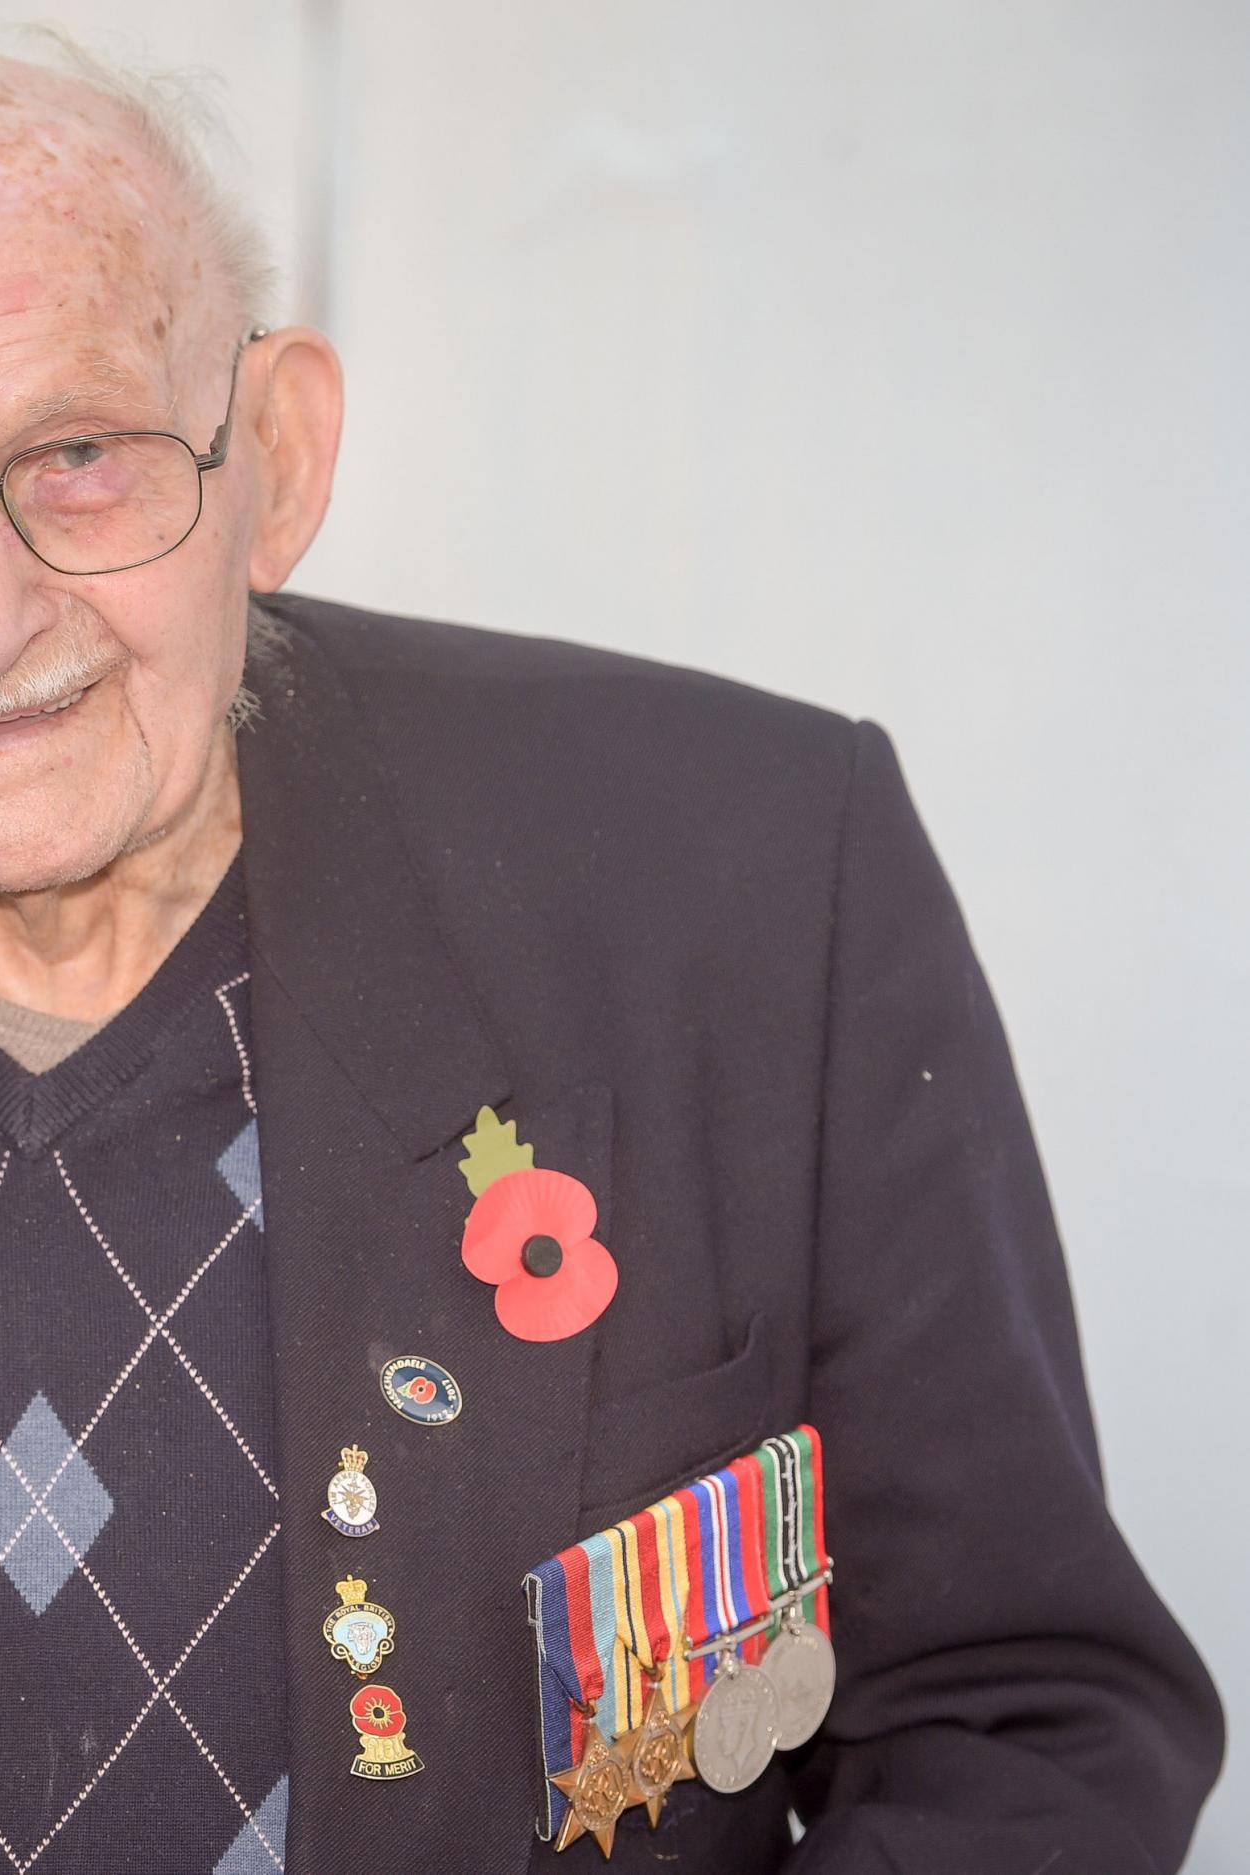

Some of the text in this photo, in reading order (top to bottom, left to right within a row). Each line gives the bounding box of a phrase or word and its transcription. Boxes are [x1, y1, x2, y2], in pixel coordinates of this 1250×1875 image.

[331, 1513, 374, 1534] VETERAN
[325, 1604, 393, 1633] THE ROYAL BRITISH
[358, 1757, 417, 1776] FOR MERIT
